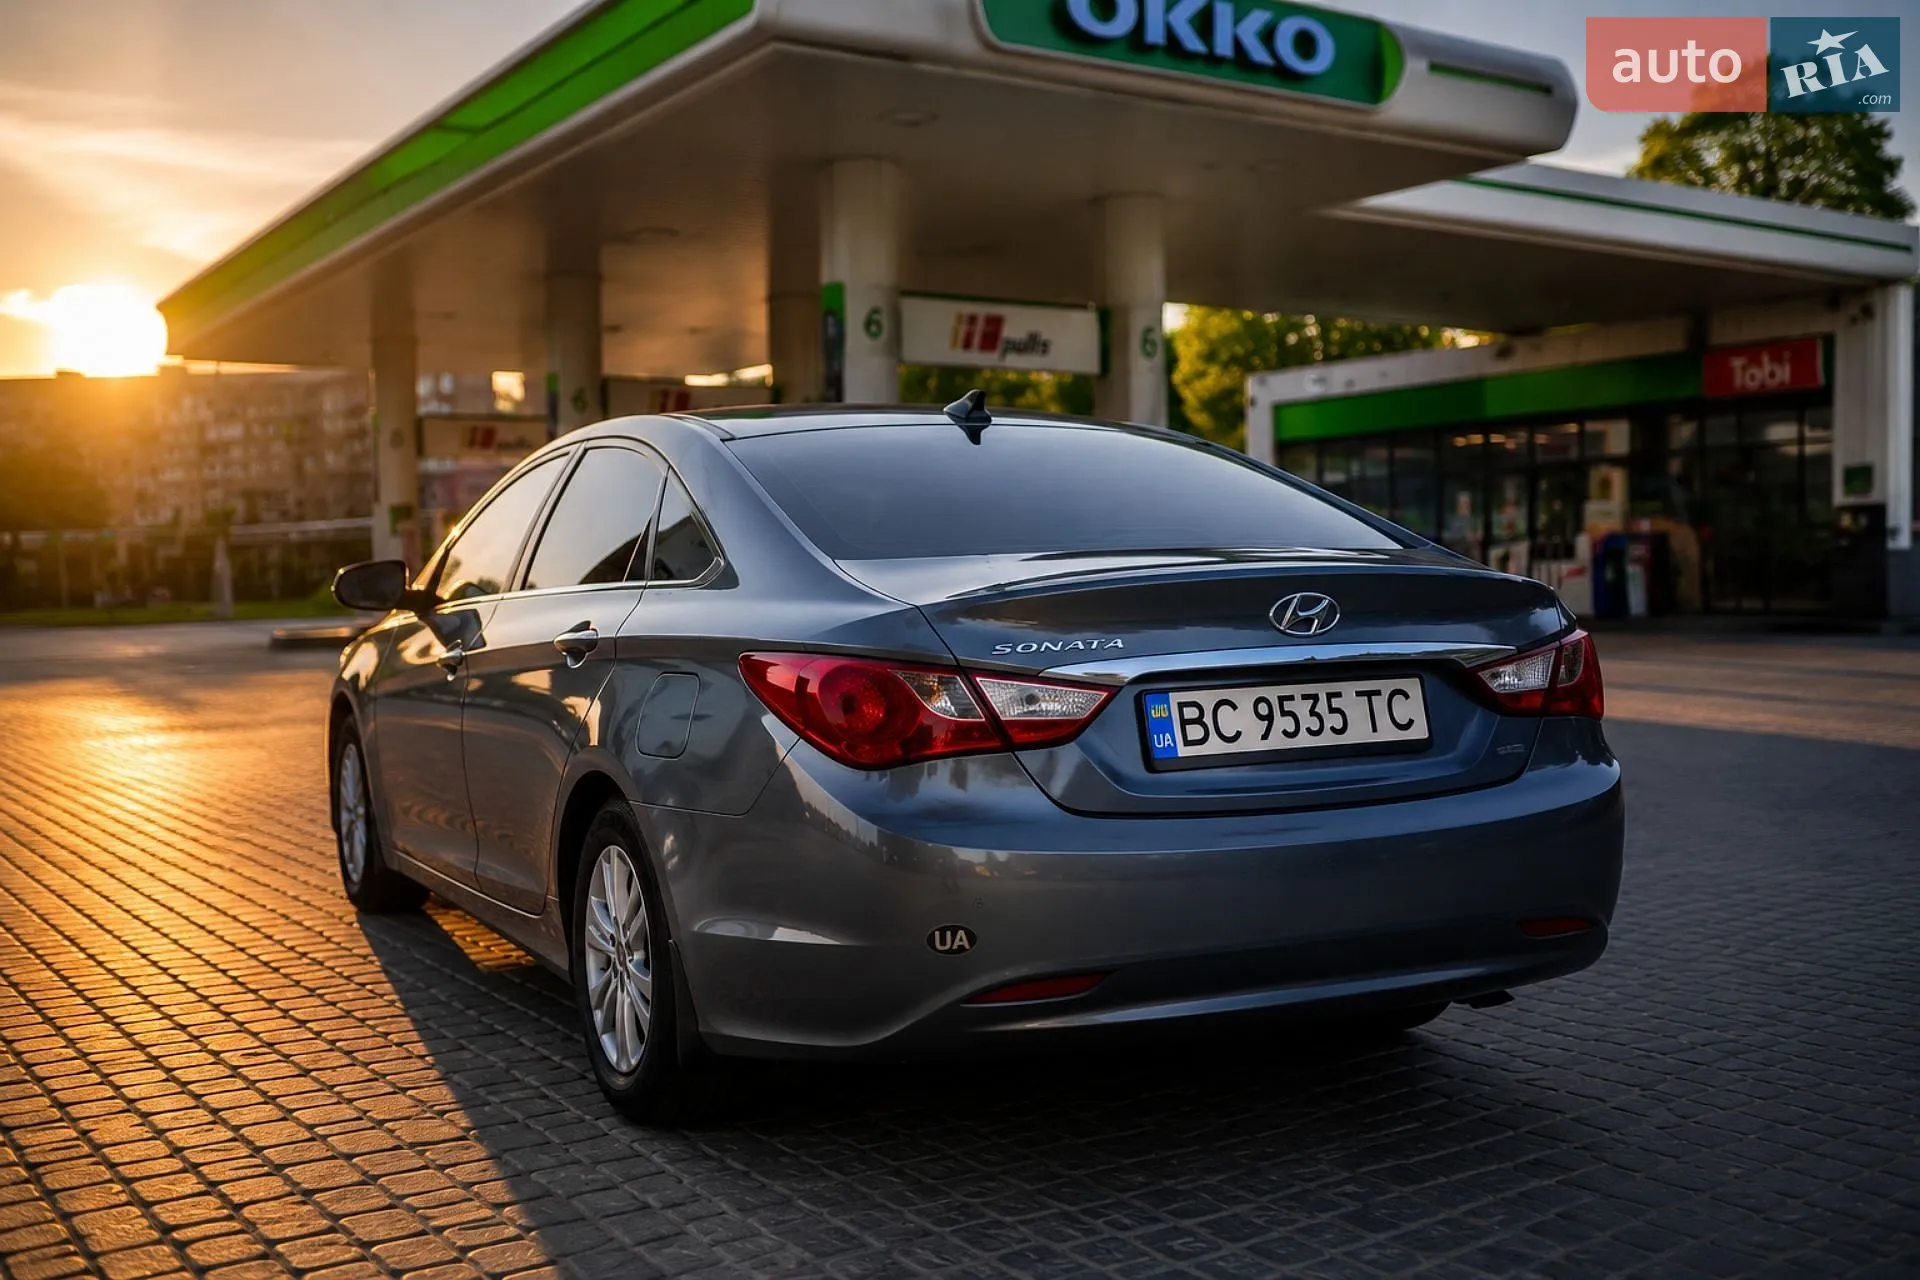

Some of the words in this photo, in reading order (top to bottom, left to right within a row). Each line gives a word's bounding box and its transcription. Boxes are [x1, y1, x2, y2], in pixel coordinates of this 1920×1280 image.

[1066, 0, 1336, 75] OKKO
[863, 306, 884, 339] 6
[1729, 350, 1792, 391] Tobi
[991, 638, 1125, 655] SONATA
[1177, 700, 1243, 748] BC
[1252, 690, 1349, 741] 9535
[1355, 687, 1415, 733] TC
[1154, 732, 1174, 749] UA
[934, 929, 971, 951] UA
